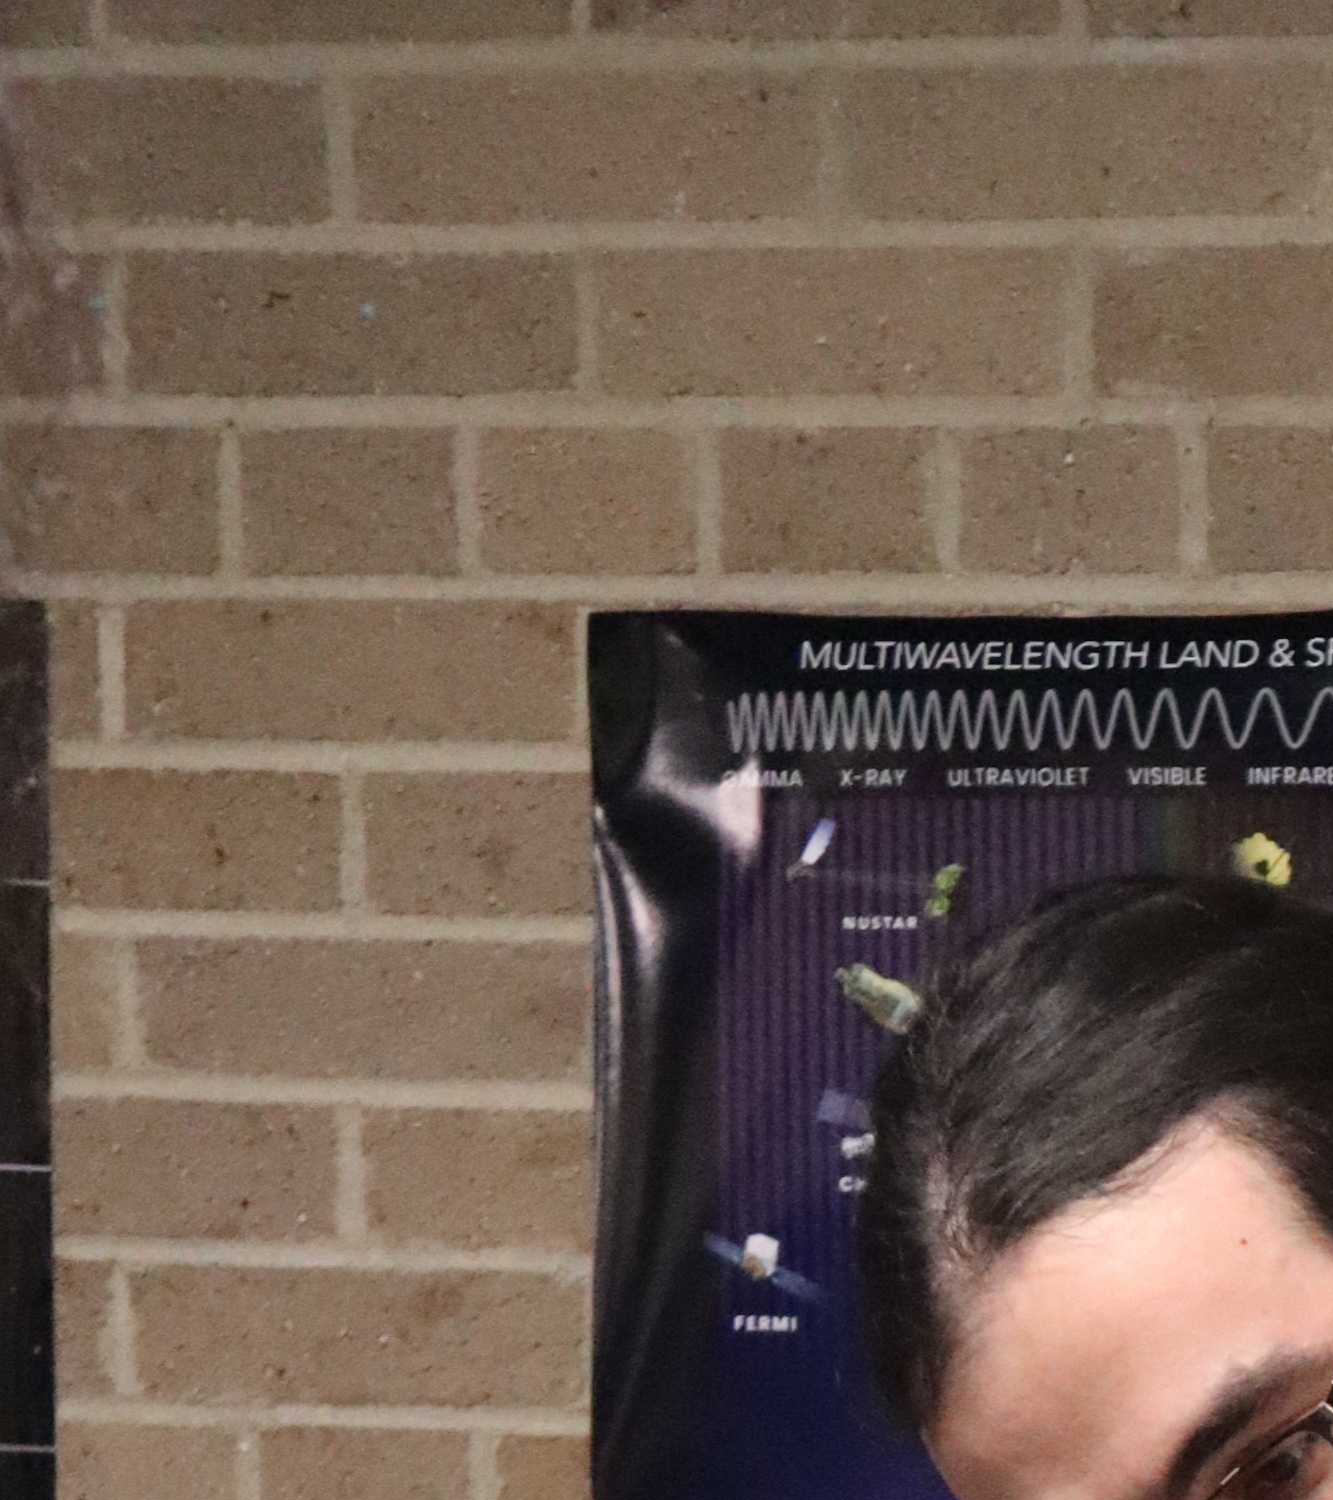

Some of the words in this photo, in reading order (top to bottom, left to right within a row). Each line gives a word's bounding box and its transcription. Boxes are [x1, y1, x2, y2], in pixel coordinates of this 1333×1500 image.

[800, 640, 1150, 671] MULTIWAVELENGTH
[1158, 639, 1260, 669] LAND
[1268, 638, 1296, 668] &
[839, 767, 908, 788] X-RAY
[947, 766, 1091, 787] ULTRAVIOLET
[1127, 766, 1208, 786] VISIBLE
[732, 1313, 799, 1333] FERMI
